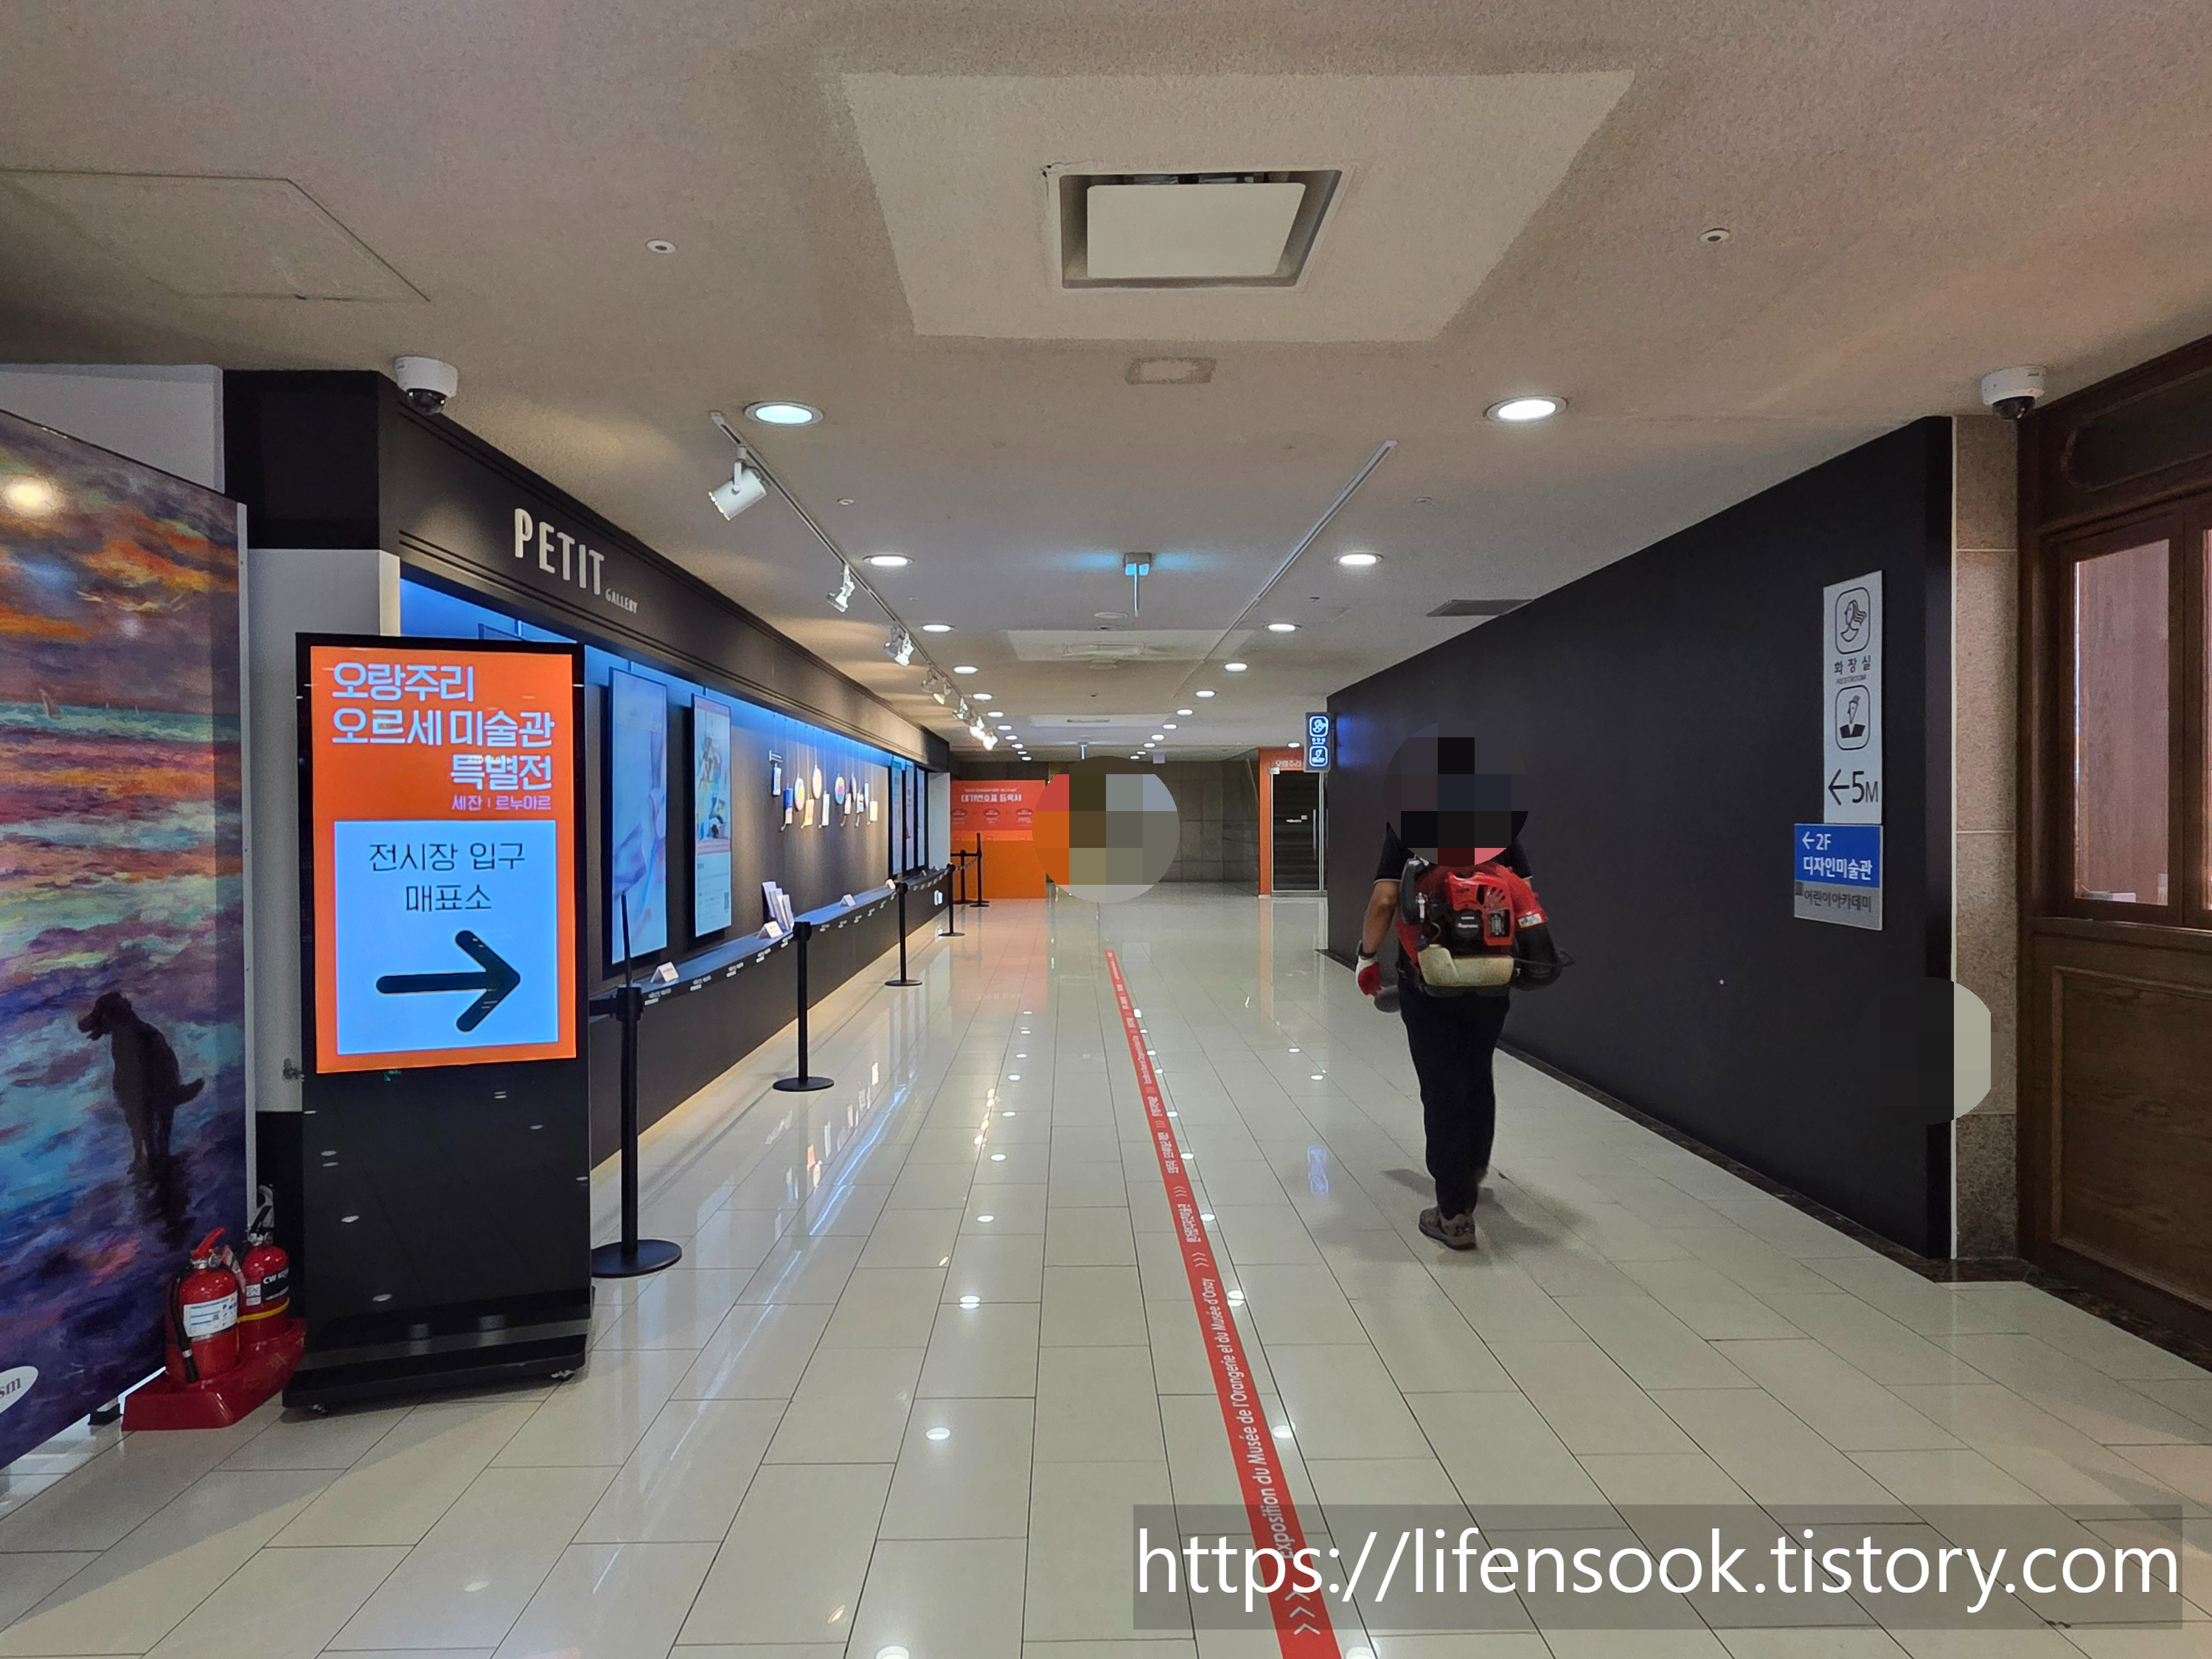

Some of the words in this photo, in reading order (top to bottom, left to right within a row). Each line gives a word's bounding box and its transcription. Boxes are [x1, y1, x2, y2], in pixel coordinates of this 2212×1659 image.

[515, 508, 605, 595] PETIT
[605, 588, 638, 613] GALLERY
[1834, 655, 1871, 675] 화장실
[332, 662, 474, 702] 오랑주리
[332, 709, 442, 746] 오르세
[449, 710, 555, 748] 미술관
[450, 754, 552, 791] 특별전
[1851, 771, 1879, 804] 5M
[451, 794, 483, 811] 세잔
[495, 795, 552, 810] 르누아르
[1815, 833, 1832, 851] 2F
[368, 843, 456, 872] 전시장
[469, 842, 526, 870] 입구
[1803, 856, 1873, 880] 디자인미술관
[405, 884, 492, 913] 매표소
[1804, 889, 1872, 913] 어린이아카데미
[1206, 1306, 1225, 1331] Musée
[1214, 1332, 1231, 1343] du
[1217, 1345, 1234, 1354] et
[1236, 1409, 1255, 1425] de
[1239, 1426, 1267, 1465] Musée
[1252, 1468, 1273, 1485] du
[1260, 1487, 1295, 1559] Exposition
